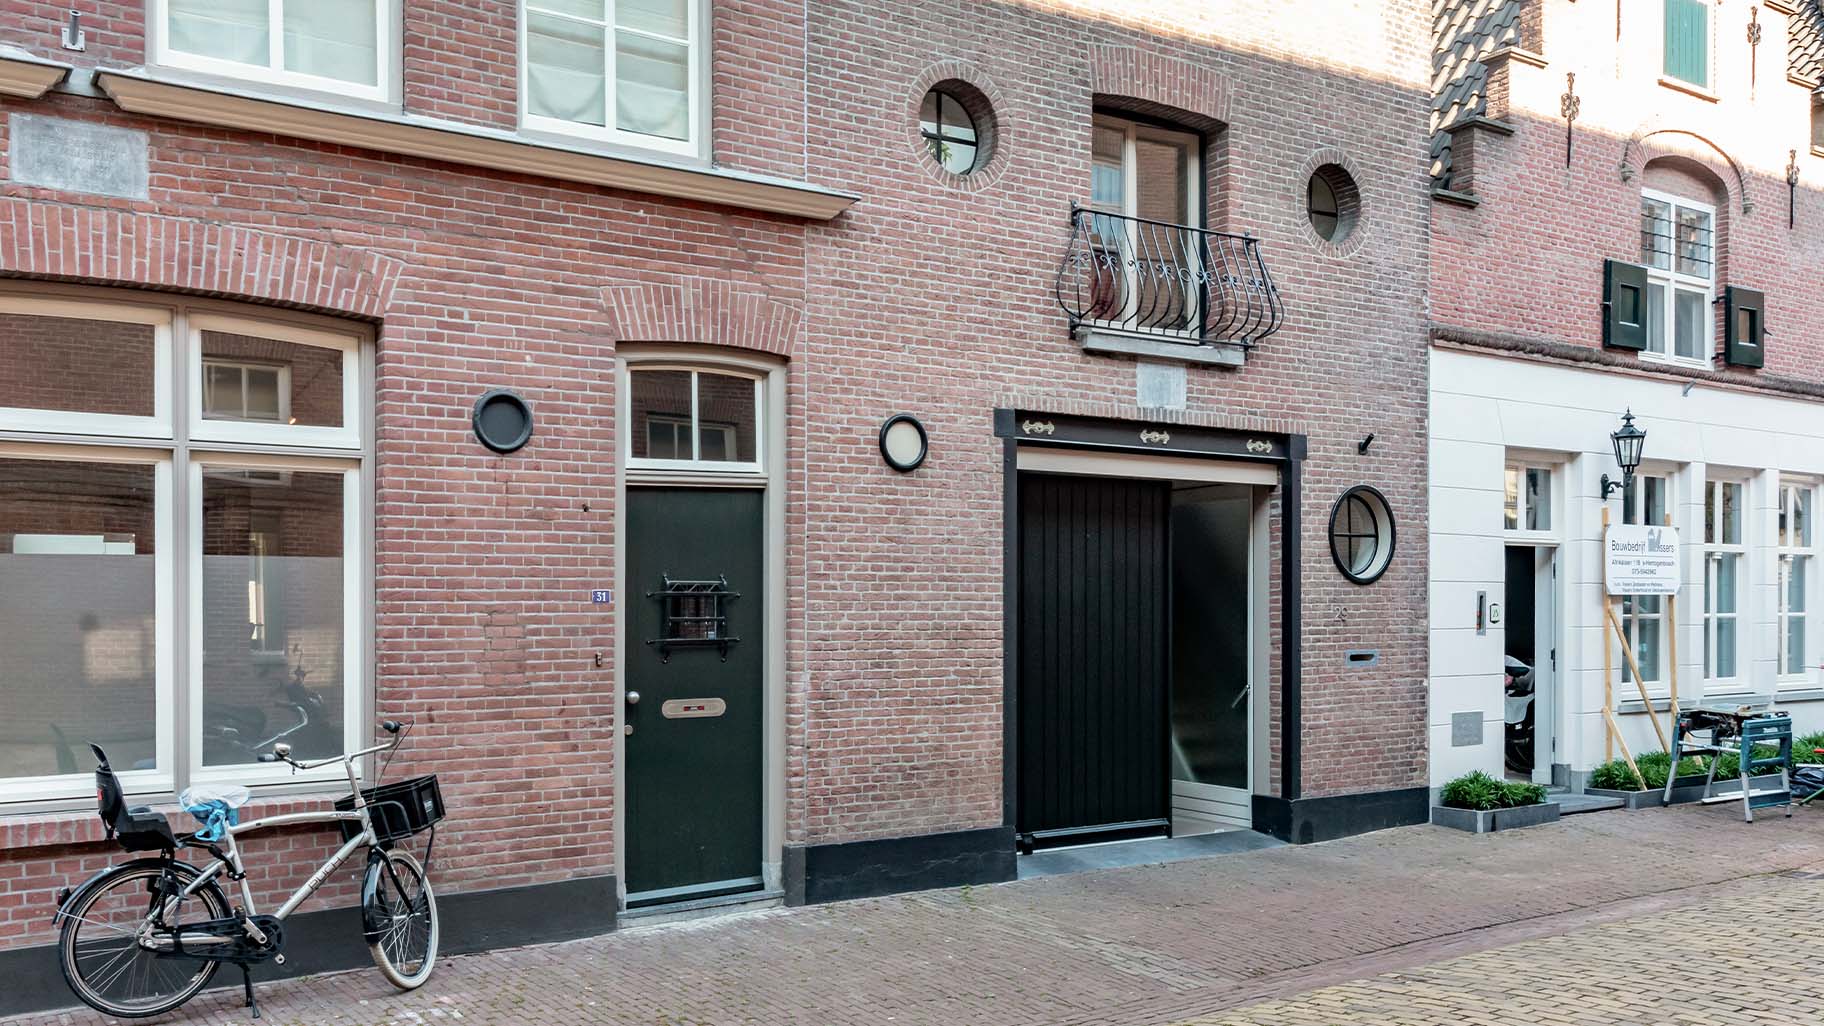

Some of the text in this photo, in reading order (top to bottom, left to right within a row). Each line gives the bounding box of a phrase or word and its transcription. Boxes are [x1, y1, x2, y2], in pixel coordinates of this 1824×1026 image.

[1611, 539, 1646, 556] Bouwbedrijf
[596, 591, 606, 602] 31
[308, 857, 343, 889] PUCH
